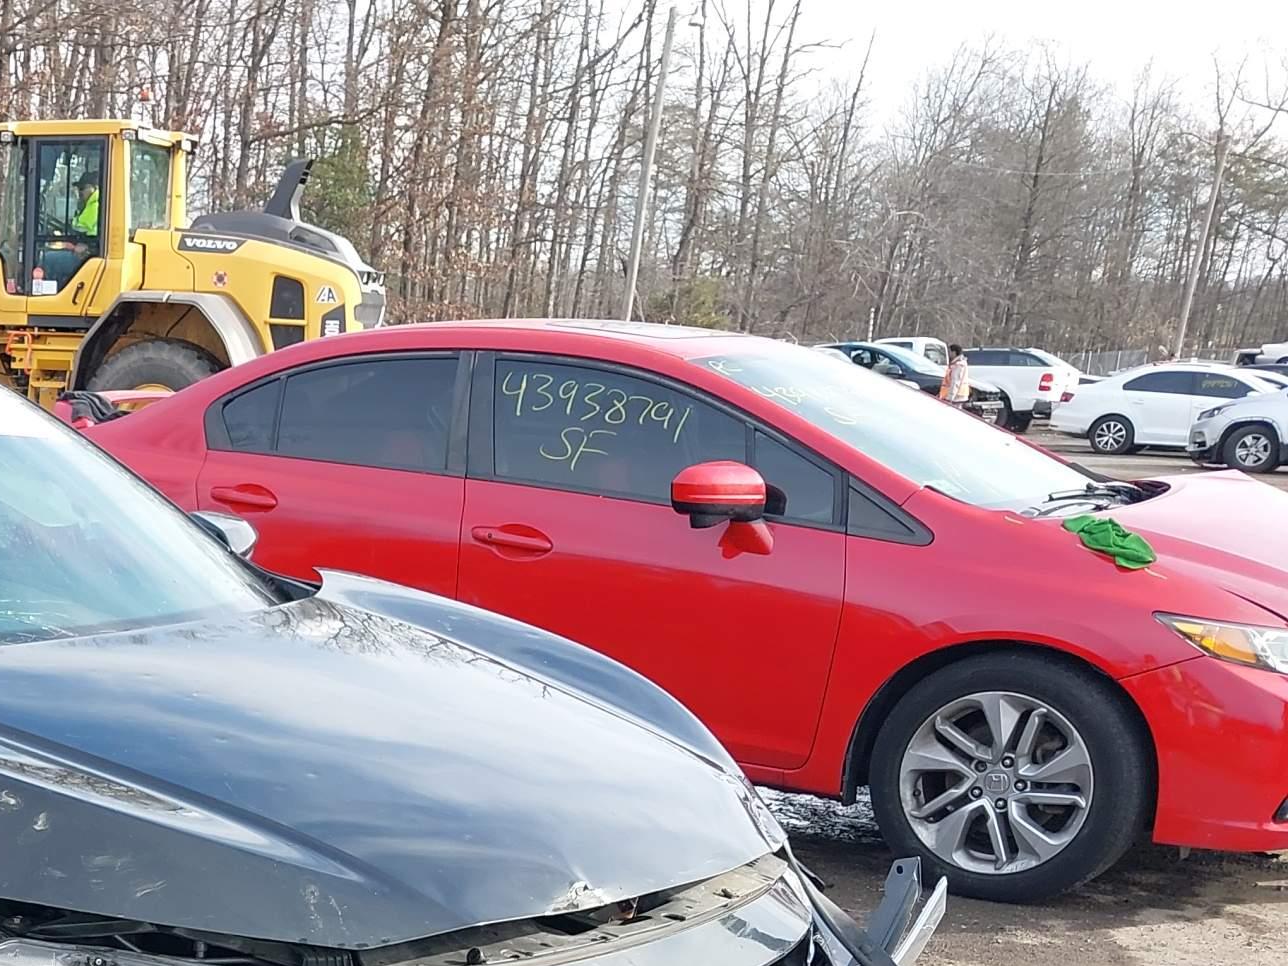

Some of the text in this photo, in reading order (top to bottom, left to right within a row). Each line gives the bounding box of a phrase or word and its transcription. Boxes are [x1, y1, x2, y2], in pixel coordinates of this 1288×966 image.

[183, 237, 237, 250] VOLVO
[502, 371, 693, 443] 43938791
[539, 427, 617, 471] SF
